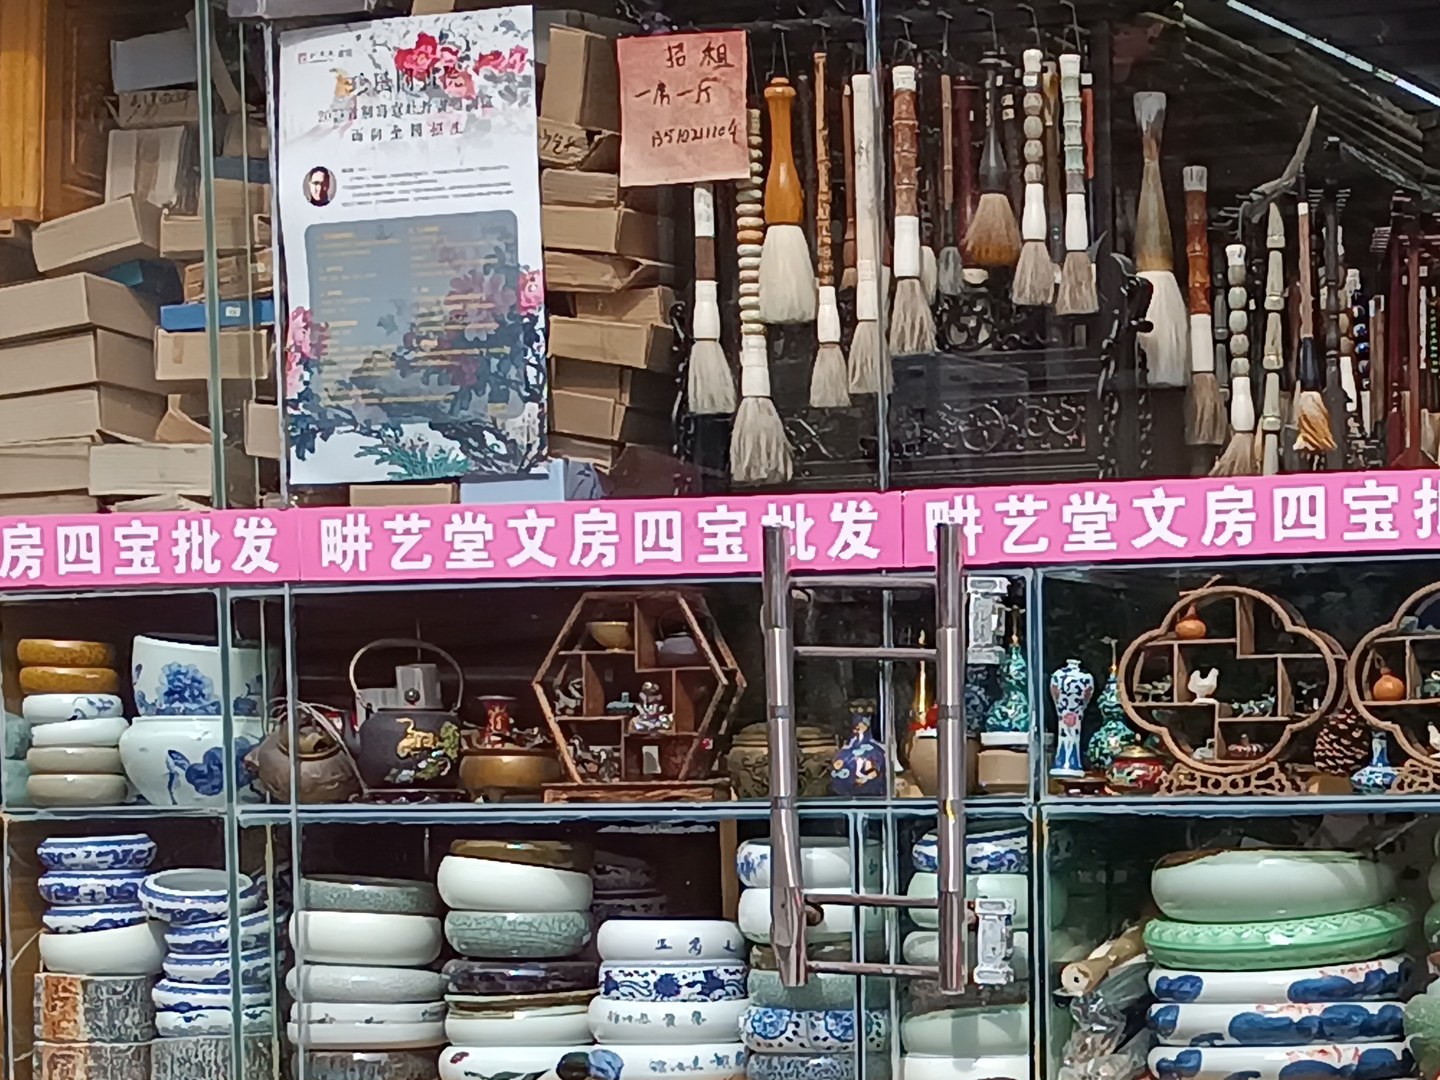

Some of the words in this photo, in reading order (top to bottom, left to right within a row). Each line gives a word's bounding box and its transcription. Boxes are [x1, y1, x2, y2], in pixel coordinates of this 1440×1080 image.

[665, 41, 735, 70] 招租
[0, 516, 279, 580] 房四宝批发
